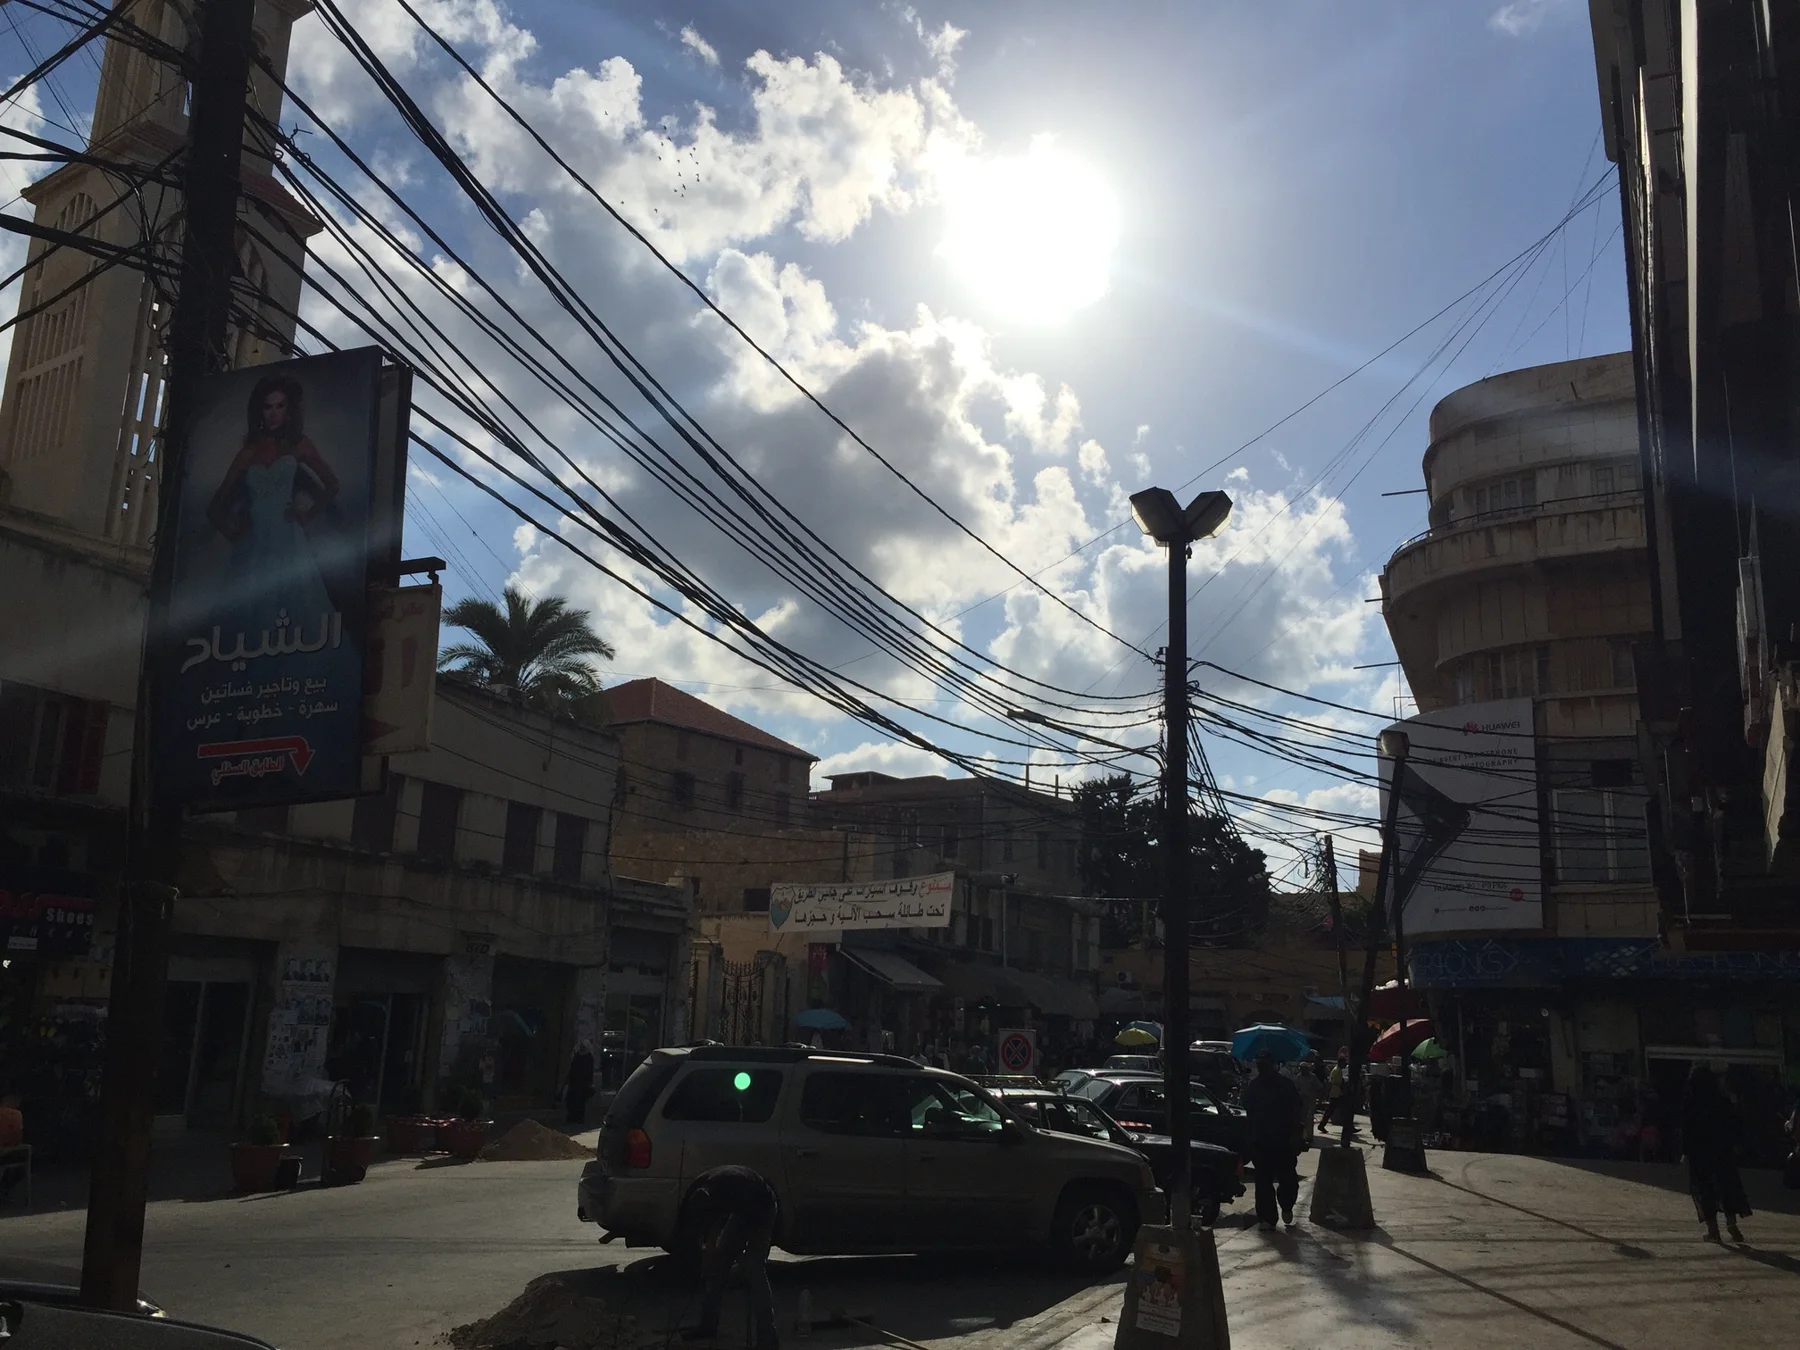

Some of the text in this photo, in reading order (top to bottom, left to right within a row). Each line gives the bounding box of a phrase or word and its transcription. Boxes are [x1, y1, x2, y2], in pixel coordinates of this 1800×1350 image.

[180, 608, 342, 674] الشياح
[201, 681, 253, 704] فساتين
[304, 676, 327, 695] بيع
[236, 703, 283, 724] خطوبة
[298, 700, 339, 719] سهرة
[186, 712, 221, 731] عرس
[1481, 721, 1520, 731] HUAWEI
[838, 886, 853, 902] على
[888, 881, 918, 897] وقوف
[918, 881, 951, 898] ممنوع
[46, 907, 93, 926] Shoes
[863, 908, 895, 924] سحب
[897, 901, 923, 918] طائلة
[926, 903, 945, 917] تحت
